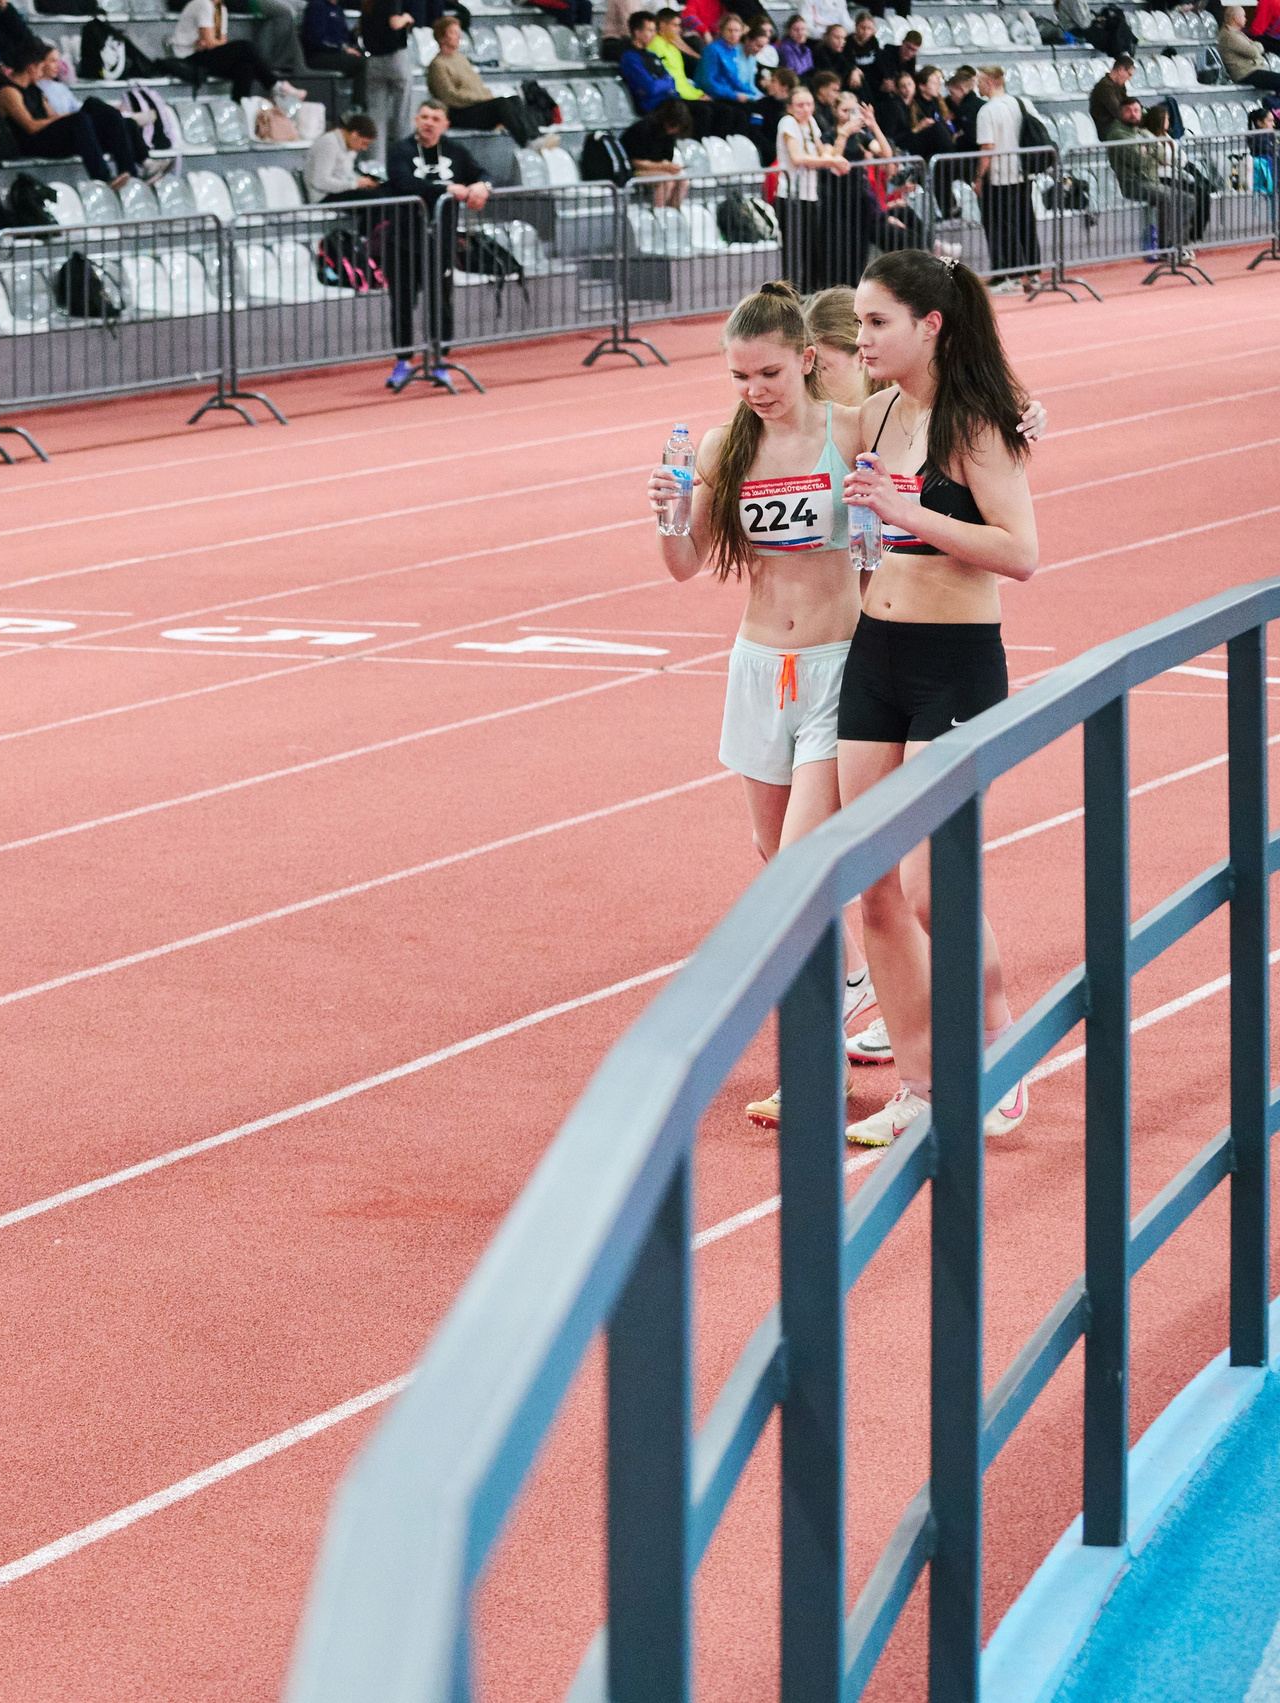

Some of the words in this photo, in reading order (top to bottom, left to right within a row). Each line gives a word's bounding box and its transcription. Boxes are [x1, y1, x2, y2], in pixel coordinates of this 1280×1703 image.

[743, 497, 818, 533] 224
[160, 626, 377, 645] 5
[453, 635, 670, 656] 4
